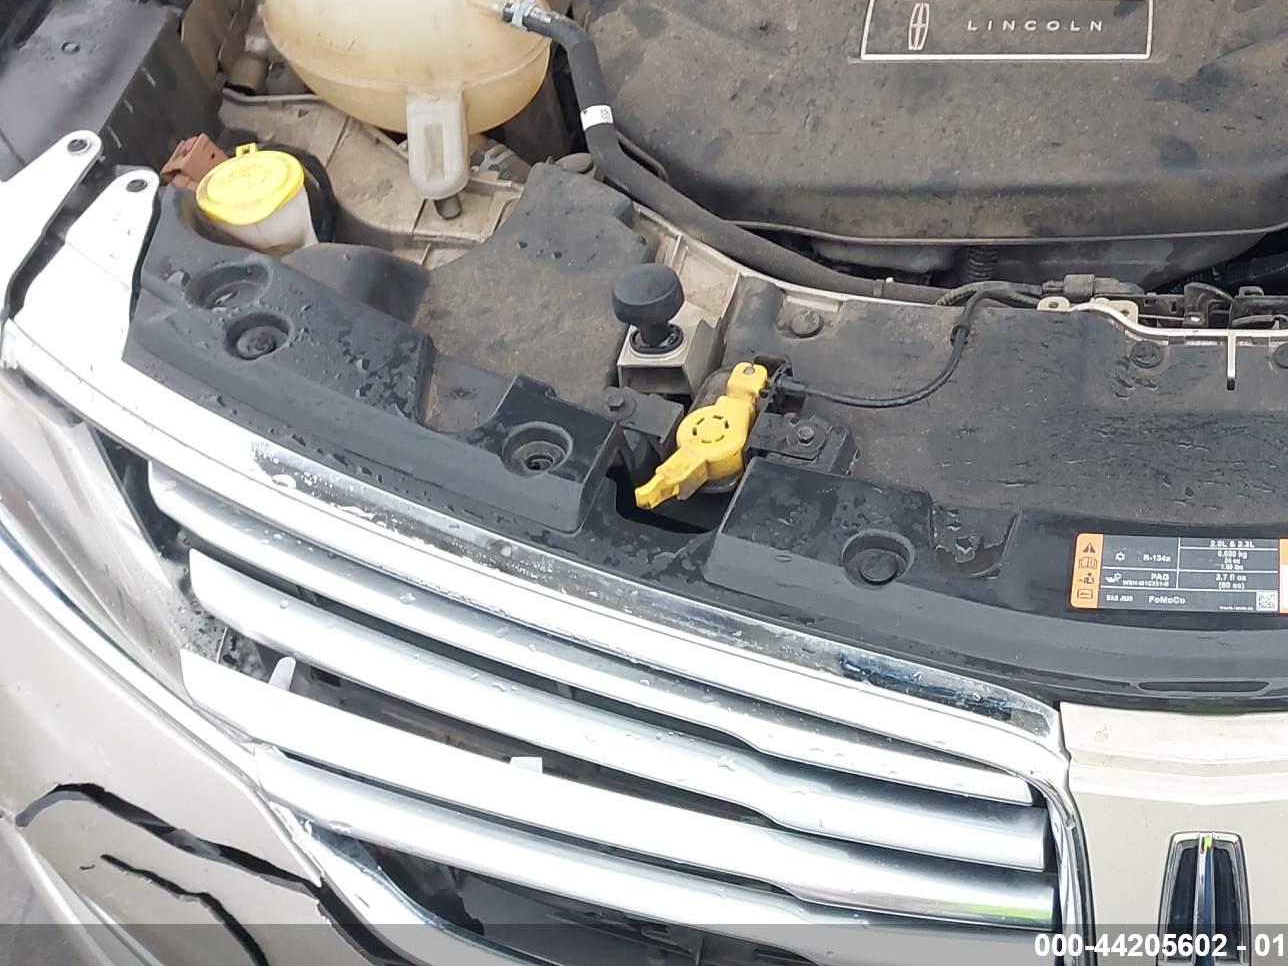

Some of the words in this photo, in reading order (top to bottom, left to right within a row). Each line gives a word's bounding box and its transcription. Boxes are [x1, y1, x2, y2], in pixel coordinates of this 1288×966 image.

[967, 20, 1104, 32] LINCOLN
[1143, 553, 1172, 562] R-134a
[1238, 550, 1248, 560] kg
[1150, 572, 1170, 581] PAG
[1148, 595, 1186, 604] FoMoCo
